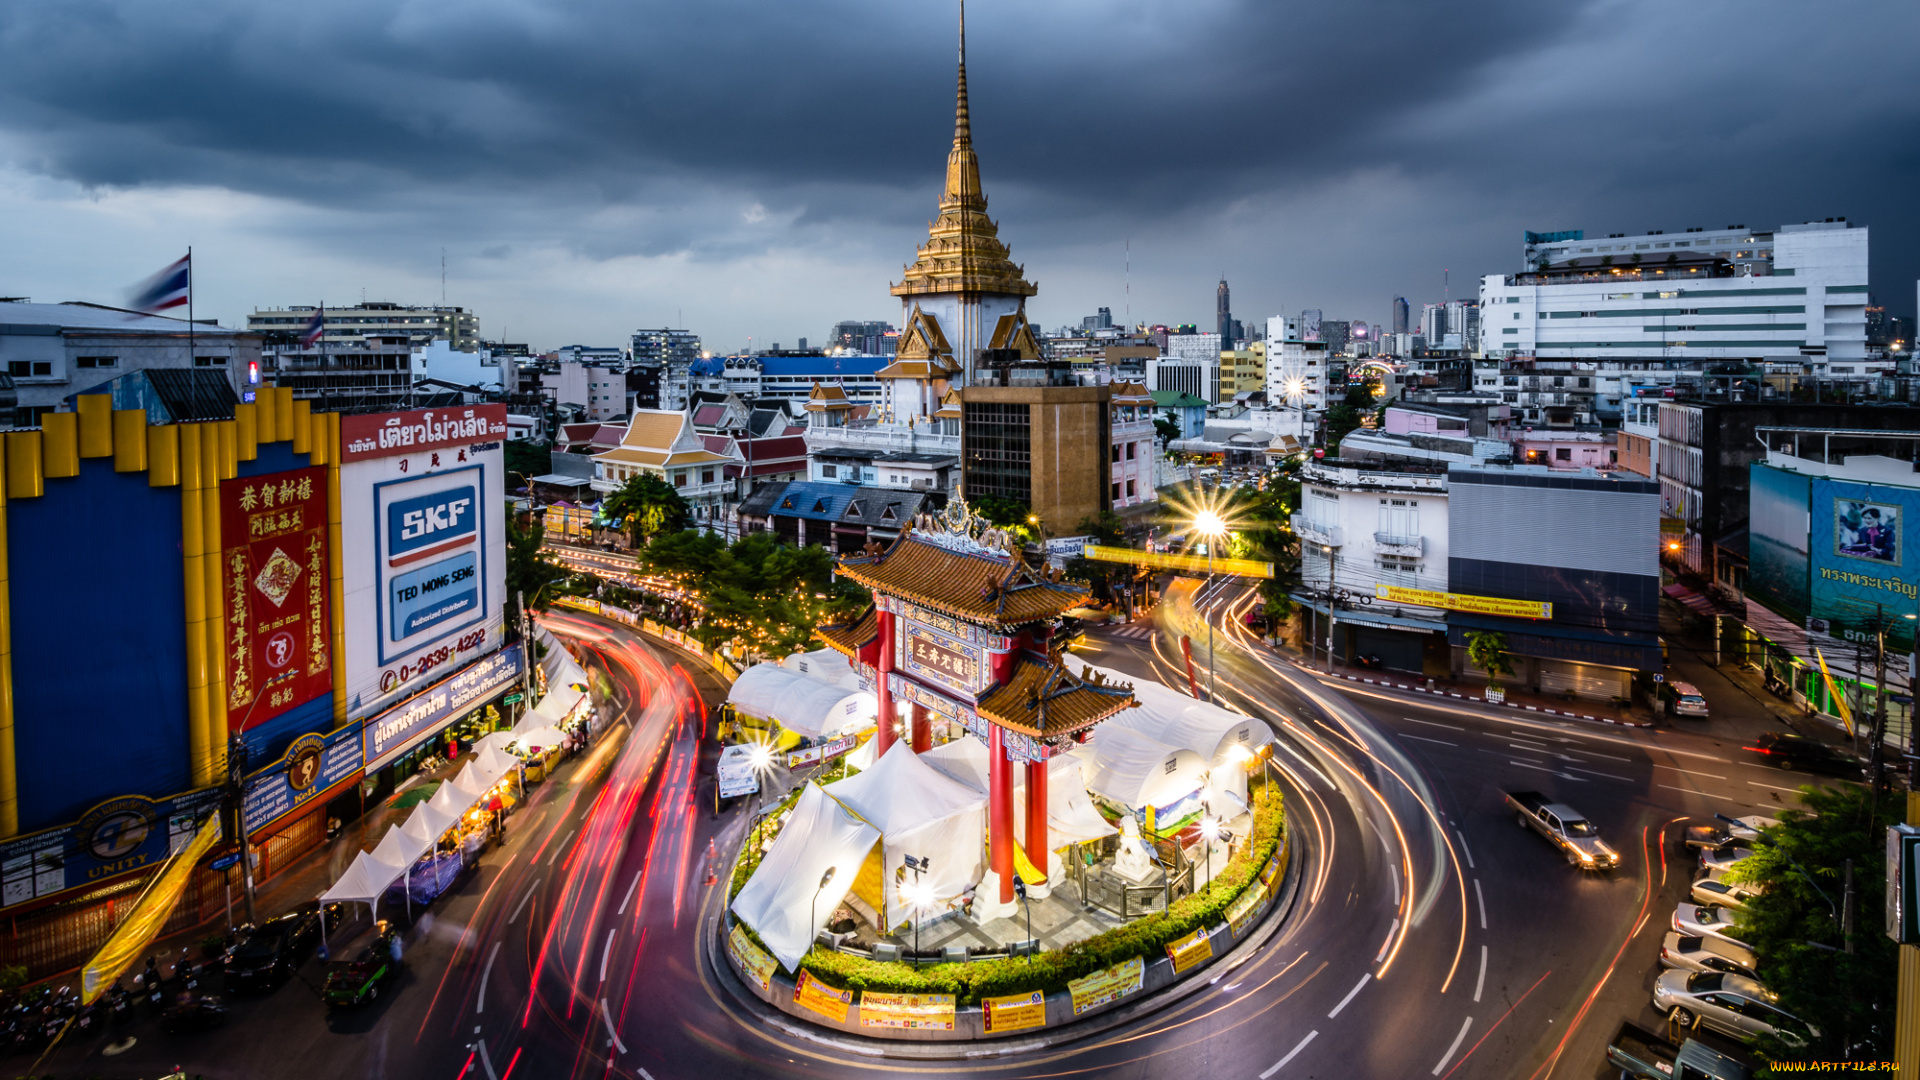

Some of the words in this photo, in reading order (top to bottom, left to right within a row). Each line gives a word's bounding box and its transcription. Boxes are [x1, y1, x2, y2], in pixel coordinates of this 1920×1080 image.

[239, 476, 313, 512] 恭賀新禧
[402, 498, 470, 540] SKF
[397, 585, 418, 603] TEO
[422, 574, 449, 595] MONG
[451, 565, 475, 584] SENG
[1820, 567, 1918, 600] ทรงพระเจริญ
[411, 608, 441, 628] Authorized
[441, 598, 469, 615] Distributor
[400, 628, 485, 682] 0-2639-4222
[374, 692, 447, 754] ผู้แทนจำหน่าย
[294, 785, 317, 805] Kett
[87, 852, 149, 879] UNITY
